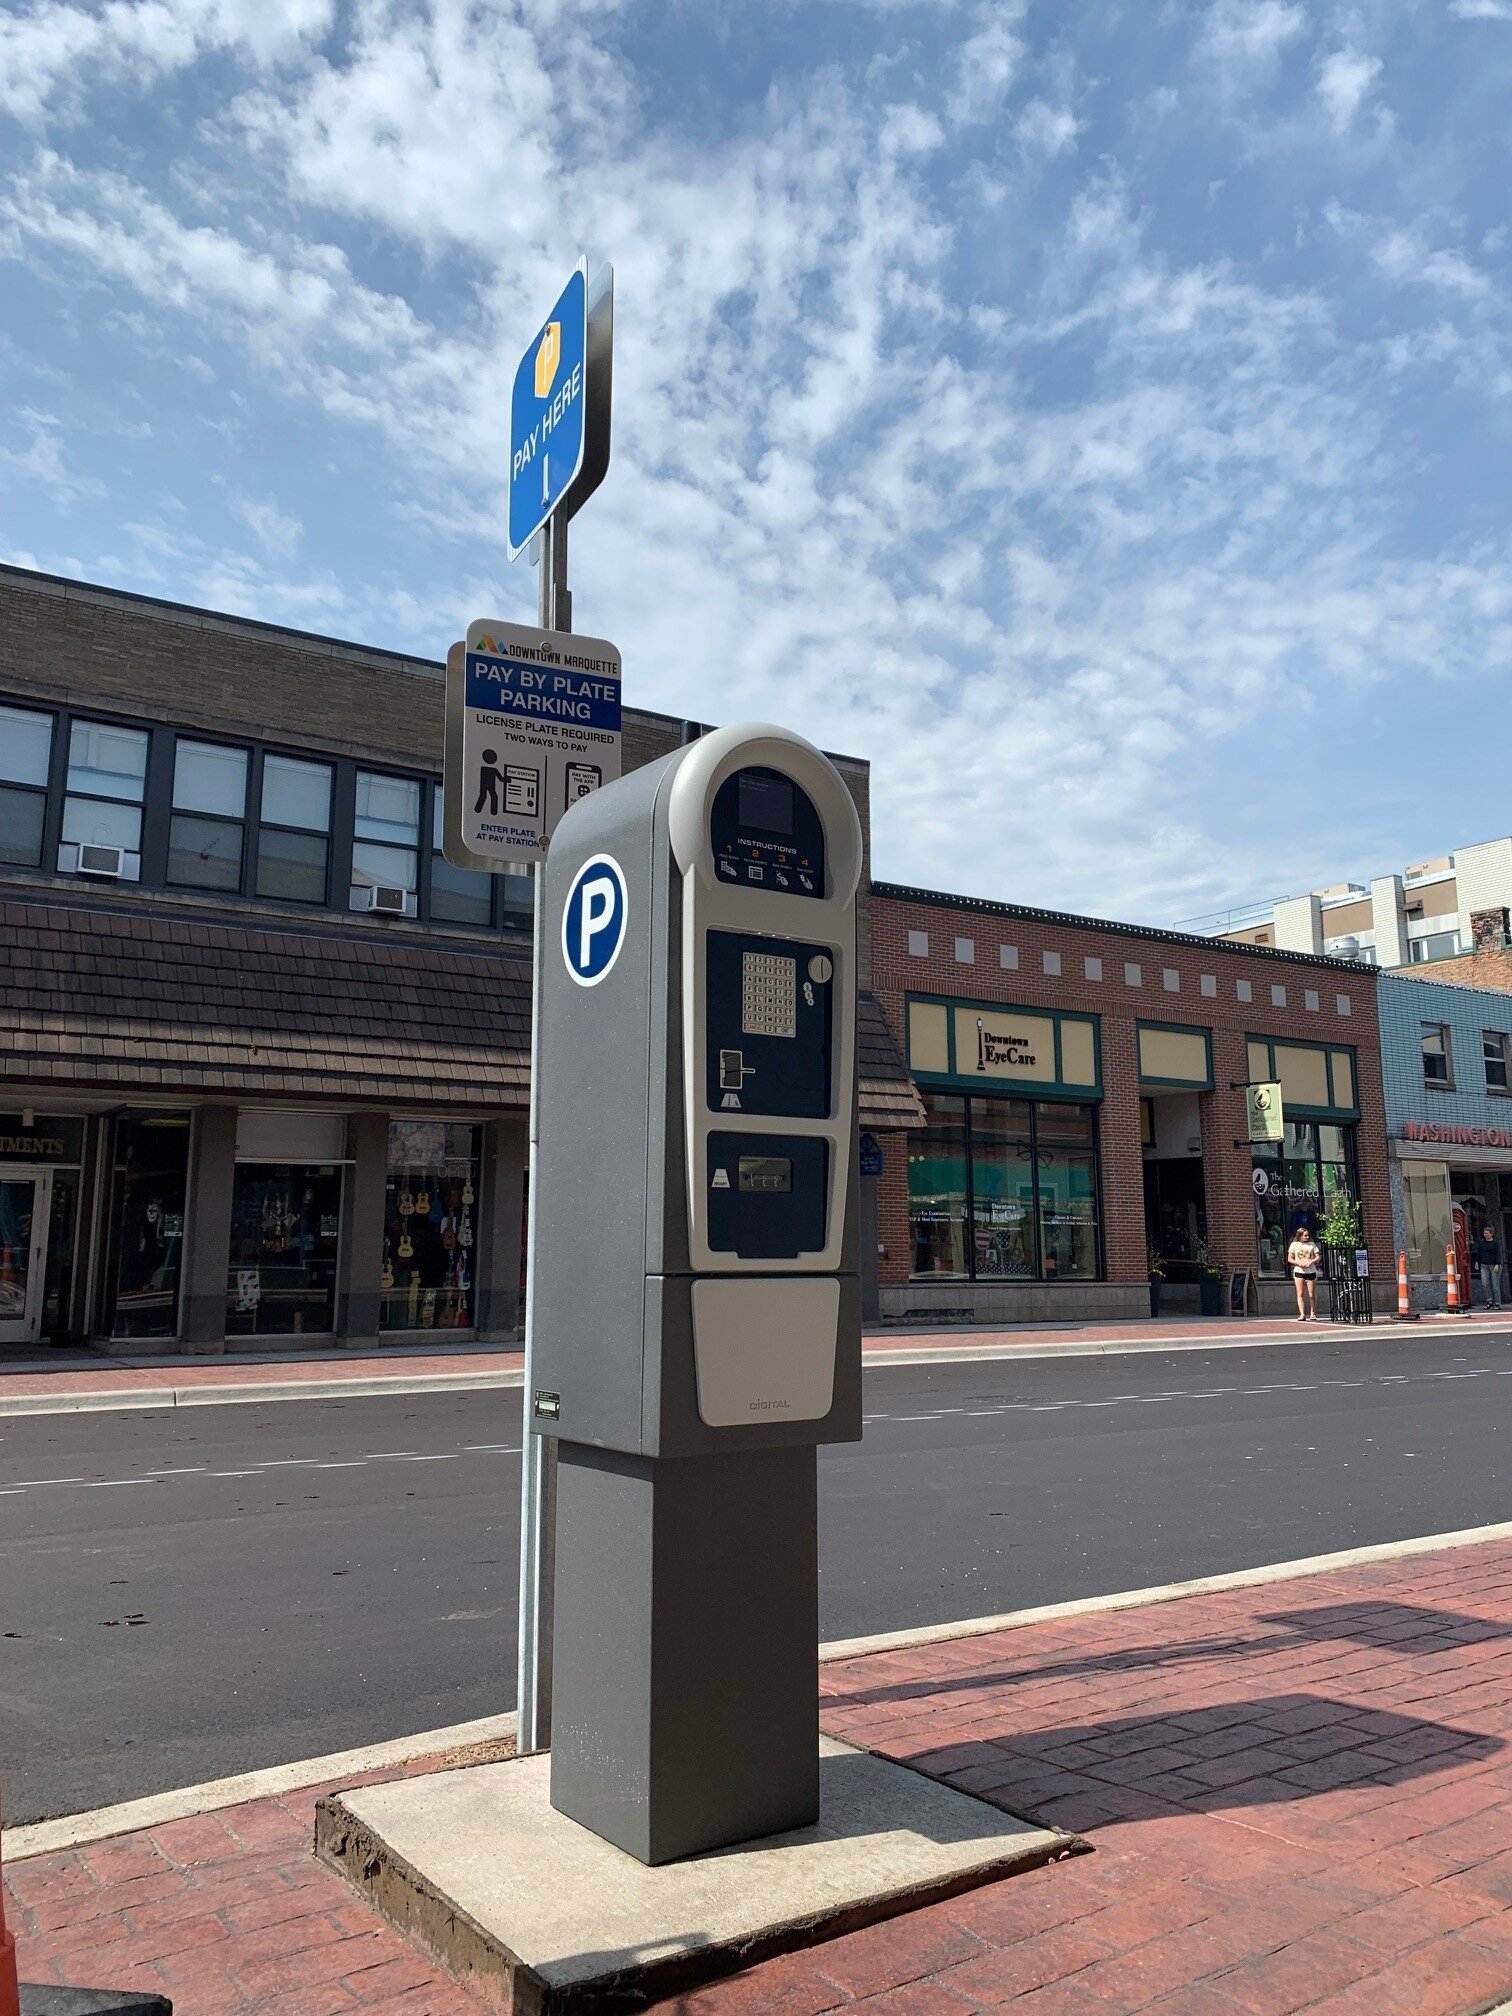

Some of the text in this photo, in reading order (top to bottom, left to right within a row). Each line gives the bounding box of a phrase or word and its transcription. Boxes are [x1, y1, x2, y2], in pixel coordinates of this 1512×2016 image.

[514, 362, 580, 482] PAY HERE
[509, 645, 617, 674] DOWNTOWN MARQUETTE
[475, 662, 616, 702] PAY BY PLATE
[500, 689, 591, 719] PARKING
[476, 714, 615, 744] LICENSE PLATE REQUIRED
[504, 732, 588, 753] TWO WAYS TO PAY
[481, 824, 536, 838] ENTER PLATE
[506, 837, 540, 847] STATION
[738, 838, 797, 854] INSTRUCTIONS
[580, 877, 615, 968] P
[984, 1032, 1028, 1047] Downtown
[985, 1045, 1036, 1065] EyeCare
[1405, 1121, 1509, 1147] WASHINGTON
[1270, 1171, 1282, 1181] The
[1270, 1180, 1319, 1198] Gathered
[992, 1210, 1021, 1220] EyeCare
